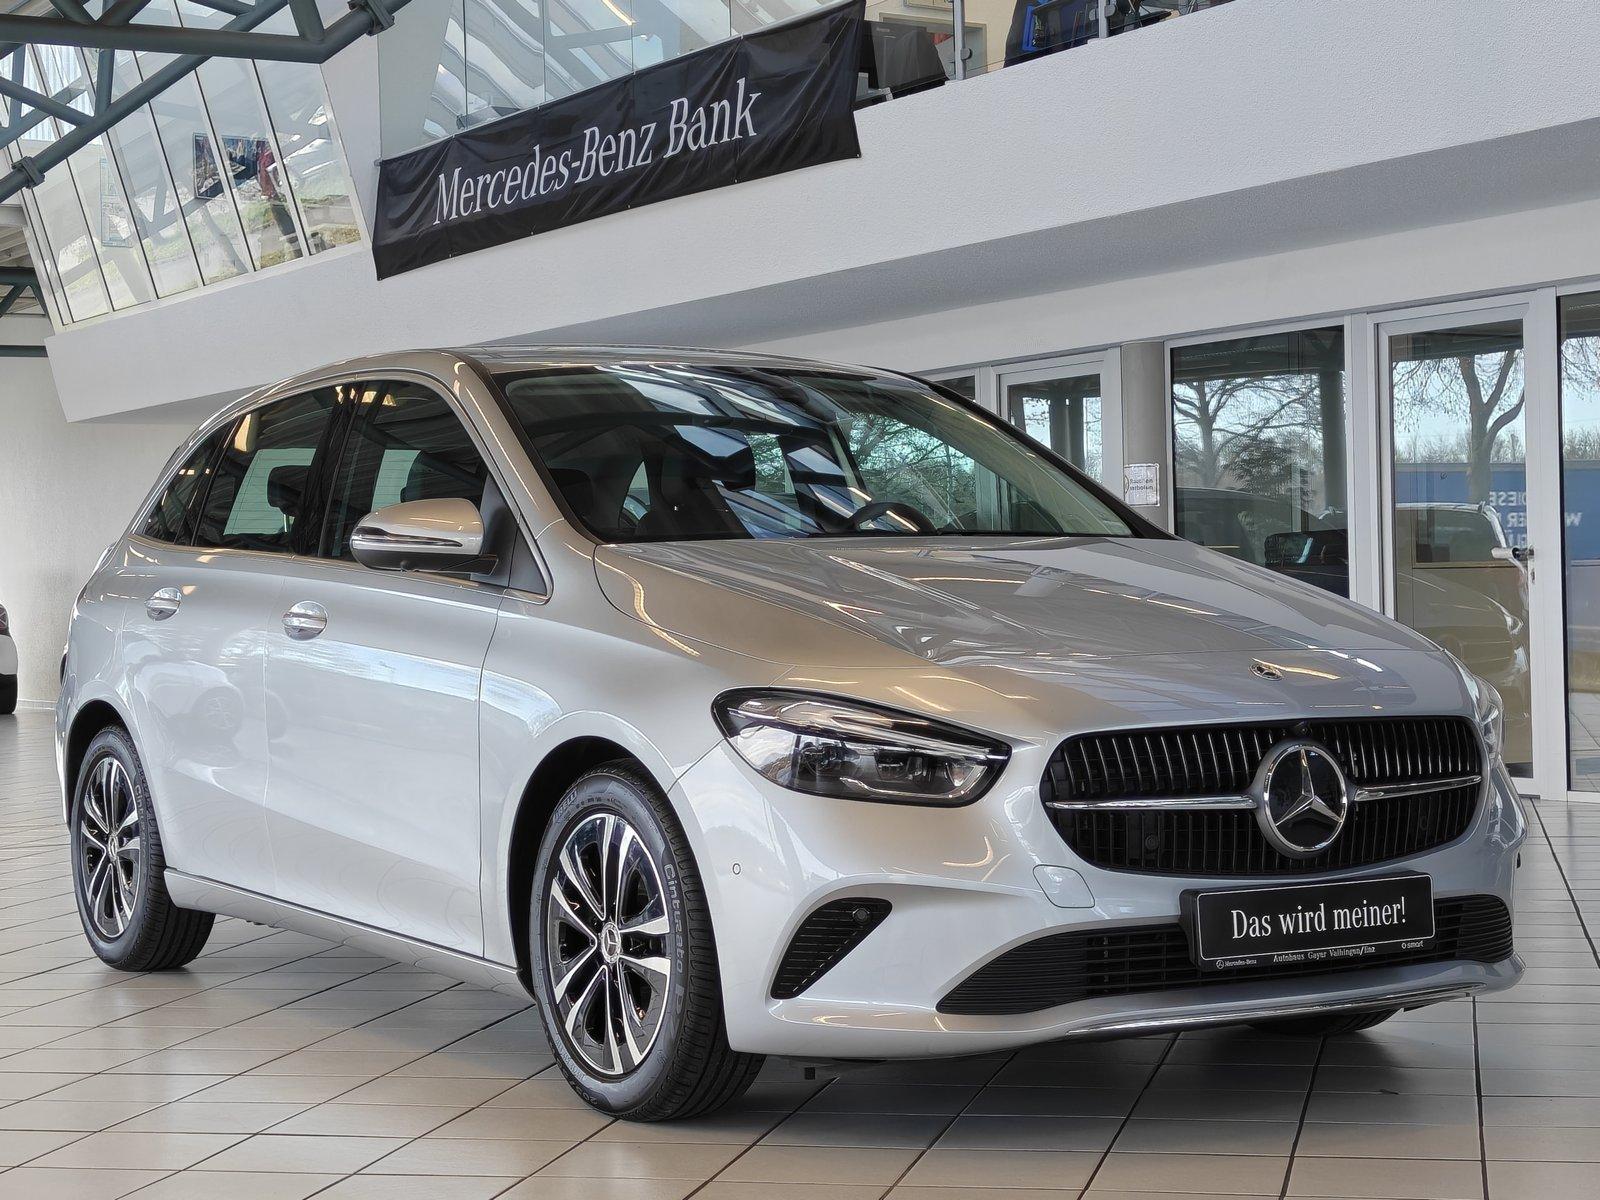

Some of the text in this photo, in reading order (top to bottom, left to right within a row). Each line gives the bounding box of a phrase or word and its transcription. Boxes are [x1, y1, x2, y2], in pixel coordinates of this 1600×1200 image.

[432, 77, 762, 225] Mercedes-Benz Bank
[664, 863, 685, 973] Cinturato
[1231, 896, 1406, 939] Das wird meiner!
[1273, 954, 1305, 963] Autohaus
[1407, 940, 1424, 949] smart
